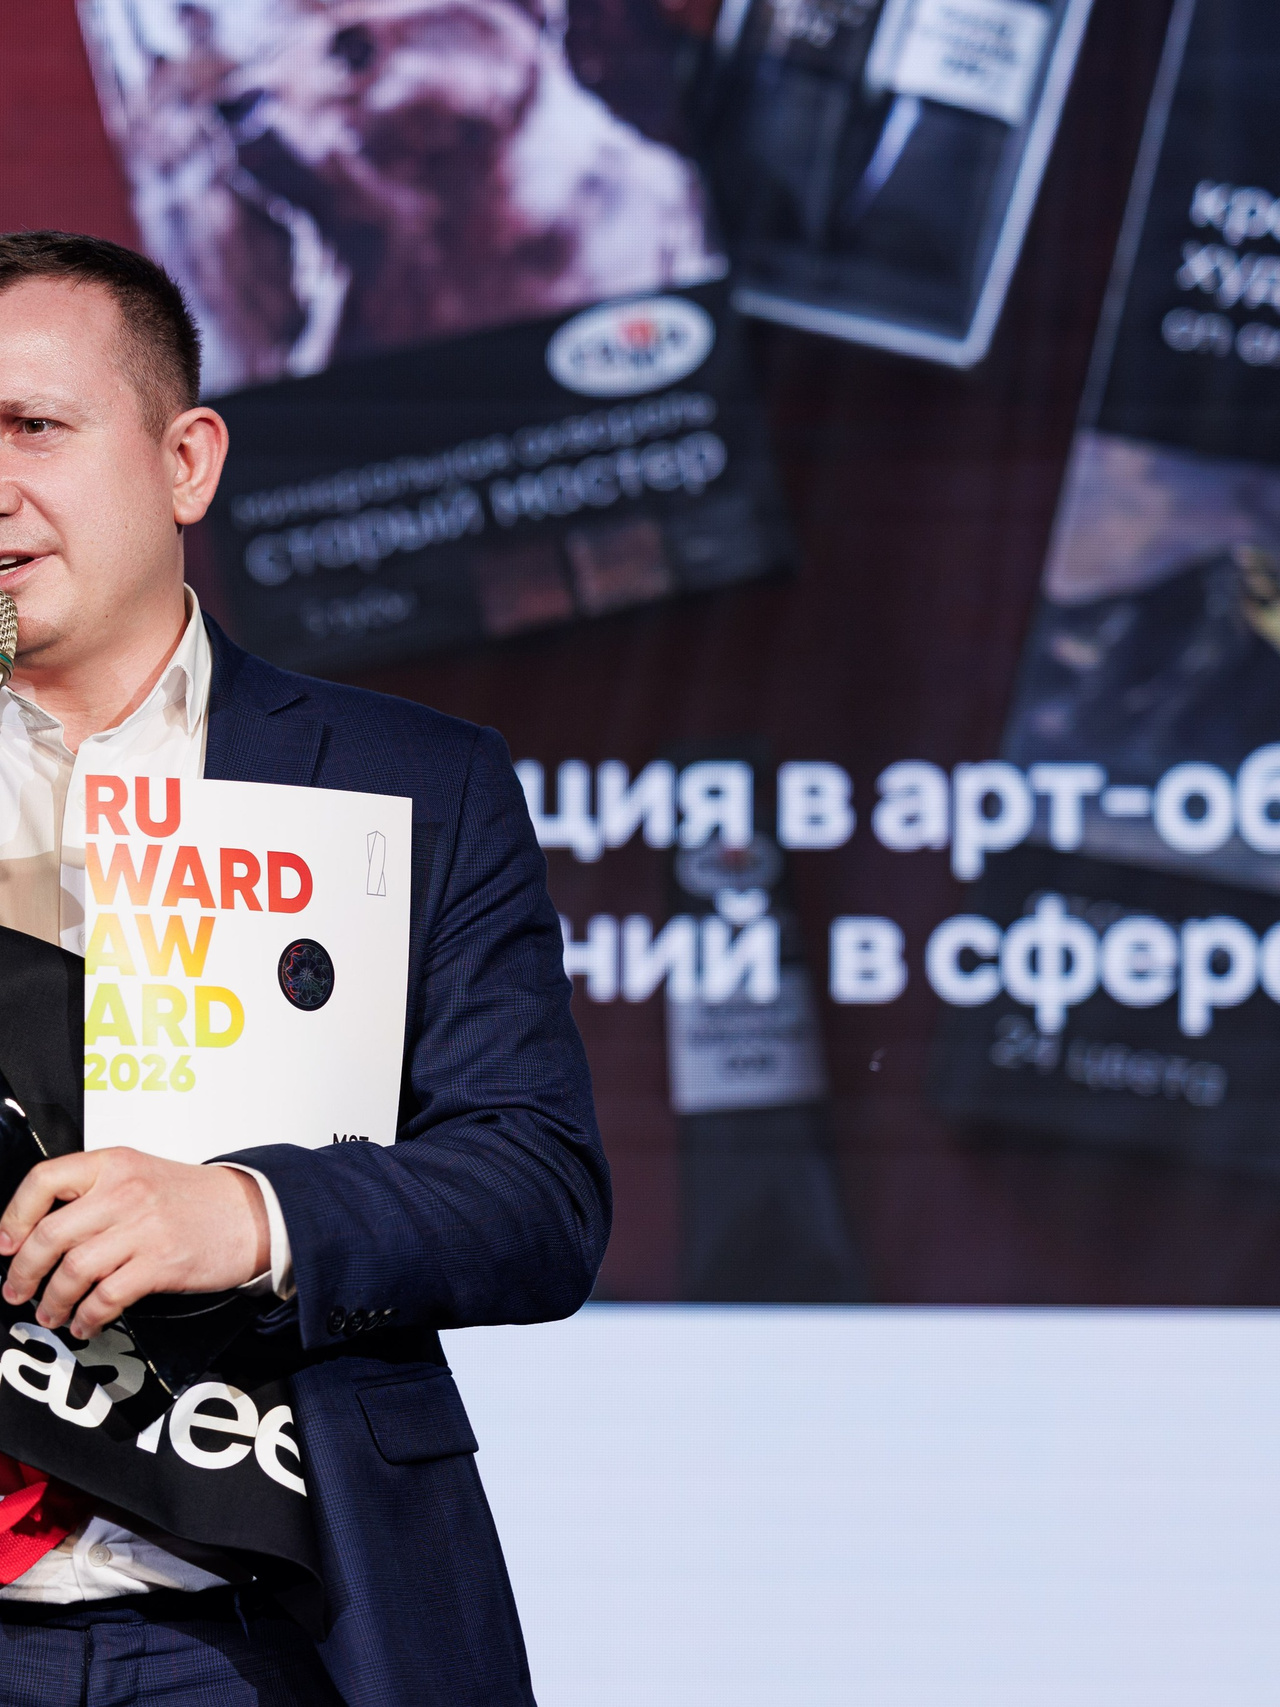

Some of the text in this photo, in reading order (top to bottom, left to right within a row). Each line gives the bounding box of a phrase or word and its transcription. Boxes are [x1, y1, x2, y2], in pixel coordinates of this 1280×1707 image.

[247, 432, 725, 584] старый мастер
[85, 774, 182, 838] RU
[516, 760, 753, 861] ция
[777, 762, 854, 849] в
[85, 842, 314, 914] WARD
[85, 912, 217, 978] AW
[830, 915, 906, 1004] в
[925, 895, 1280, 1035] сфер
[84, 982, 246, 1049] ARD
[84, 1053, 197, 1093] 2026
